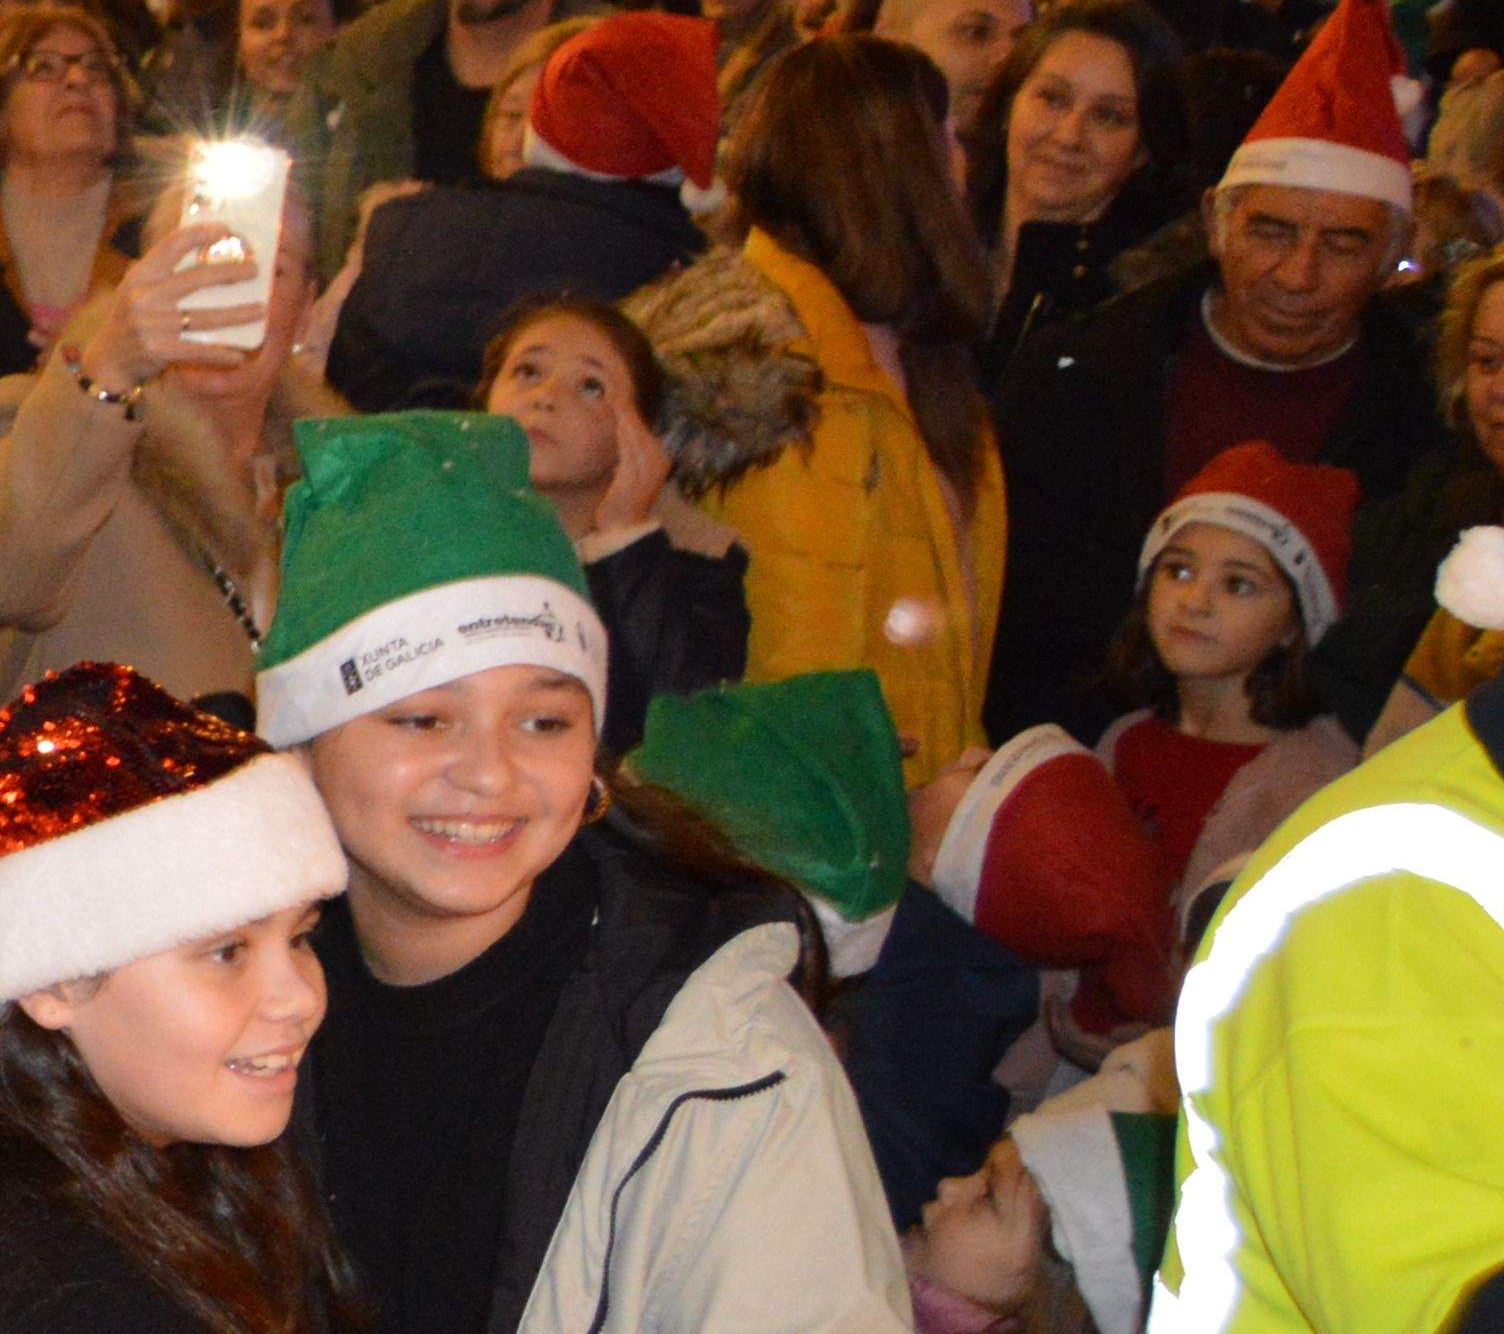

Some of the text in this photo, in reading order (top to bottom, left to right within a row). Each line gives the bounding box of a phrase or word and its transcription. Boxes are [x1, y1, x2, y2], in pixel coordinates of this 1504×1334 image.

[360, 636, 408, 666] XUNTA
[365, 667, 384, 682] DE
[386, 637, 445, 672] GALICIA
